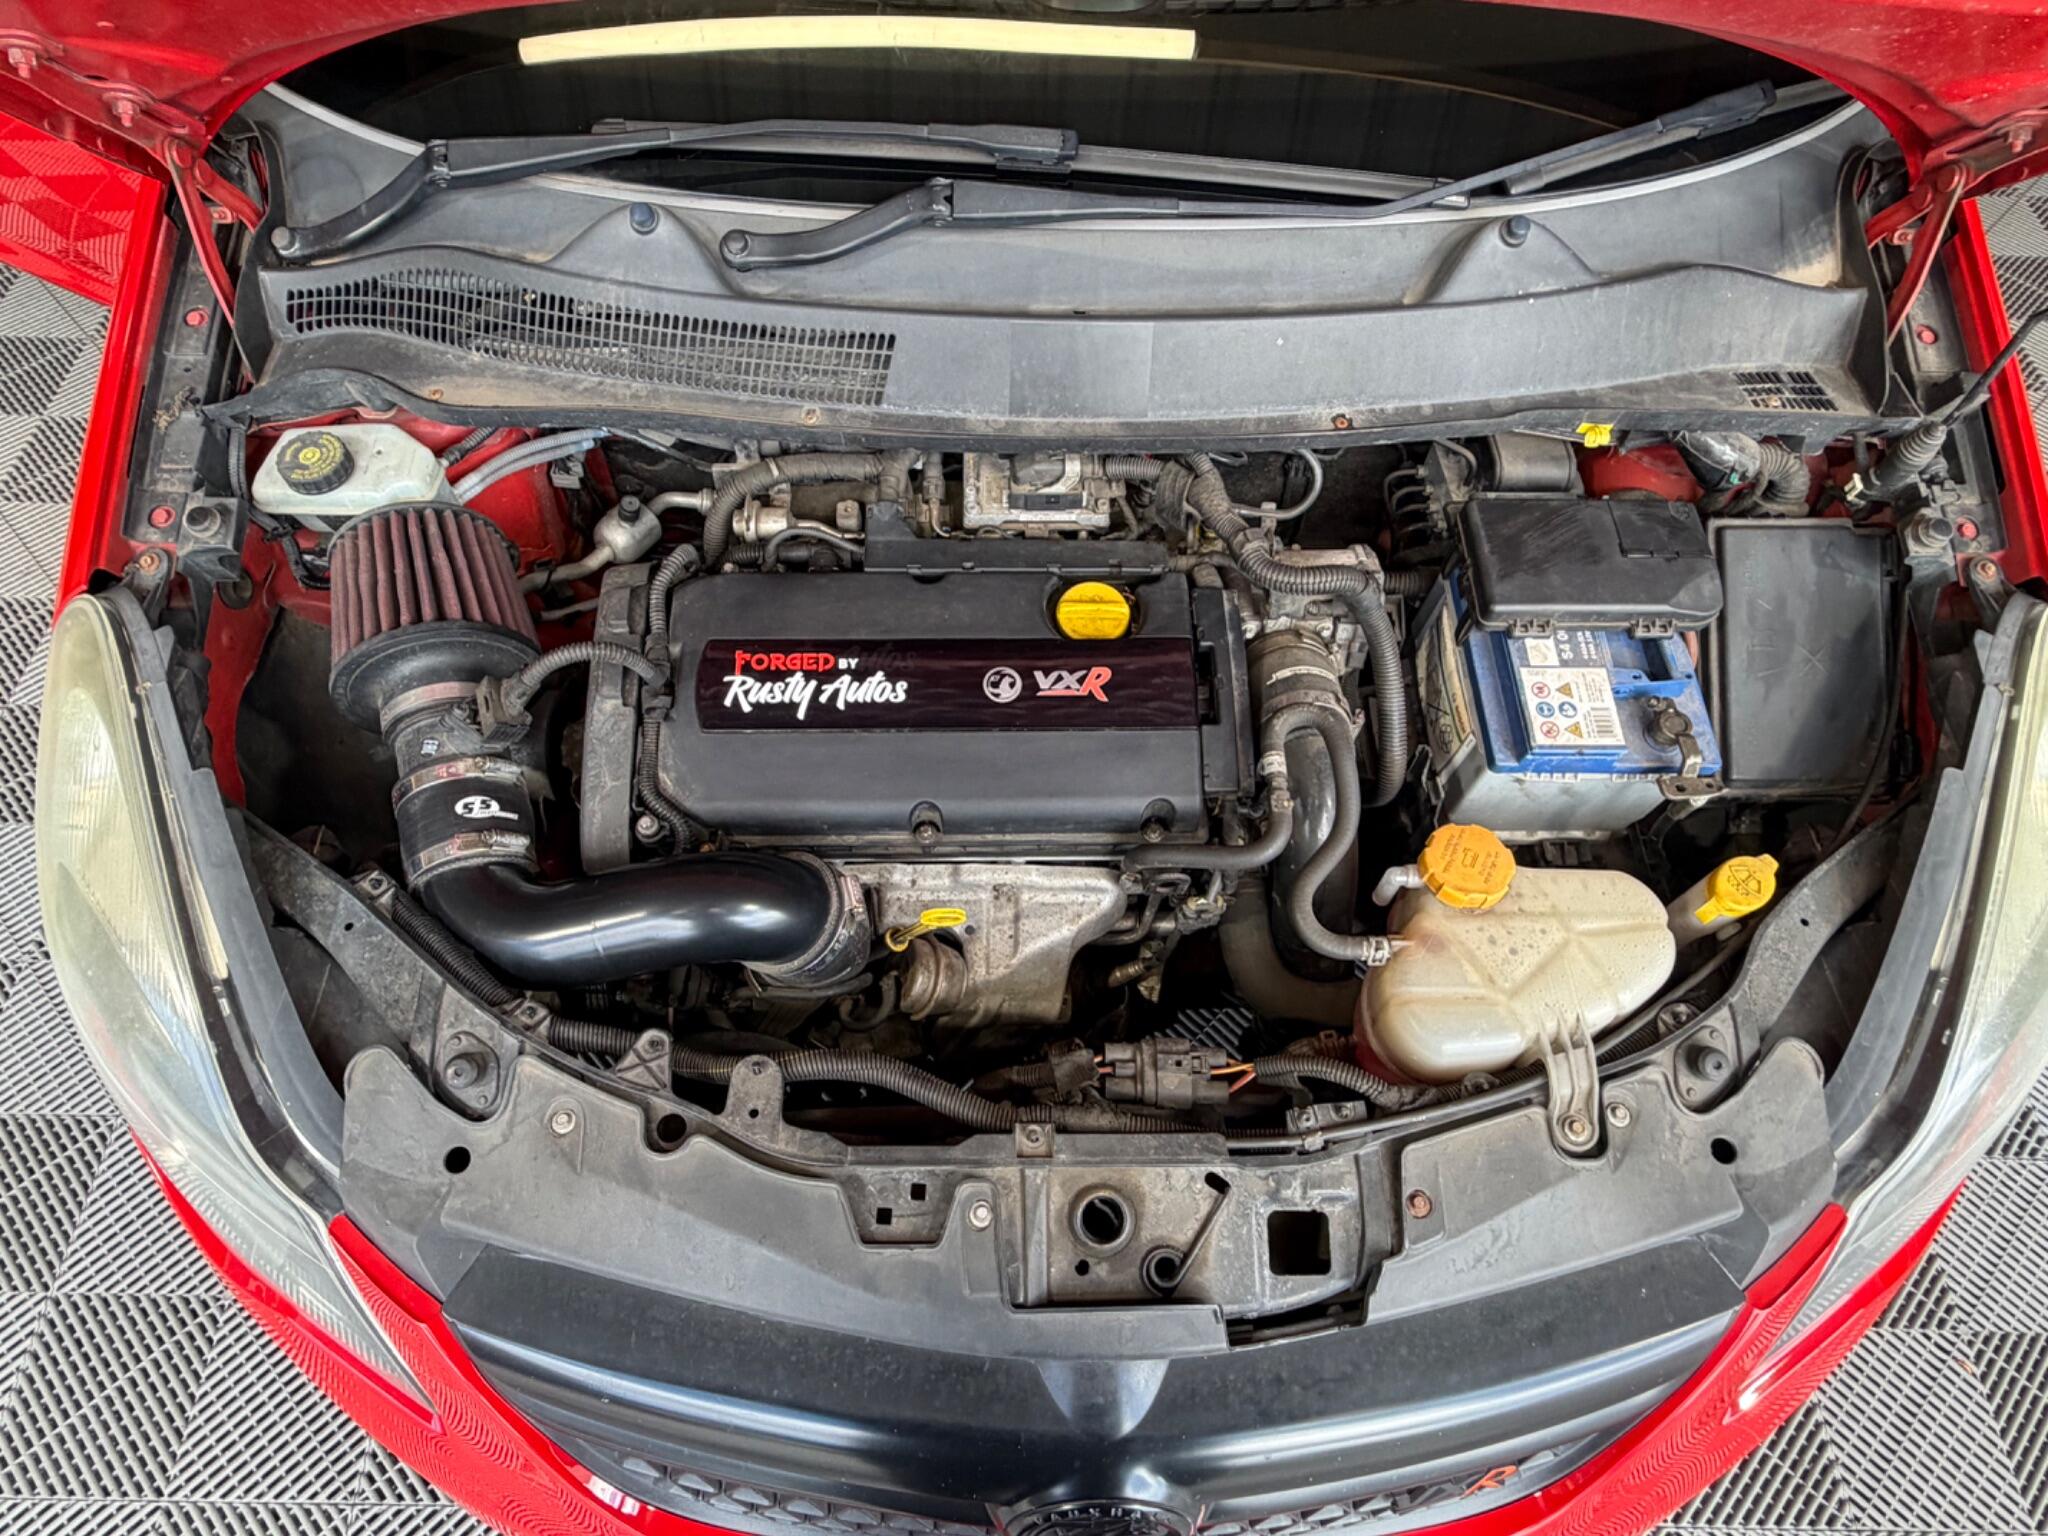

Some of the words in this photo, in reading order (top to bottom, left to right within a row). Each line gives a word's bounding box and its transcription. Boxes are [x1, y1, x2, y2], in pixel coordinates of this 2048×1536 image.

[735, 650, 836, 675] FORGED
[838, 658, 859, 670] BY
[722, 671, 818, 720] Rusty
[819, 670, 908, 711] Autos
[1033, 666, 1112, 702] VXR
